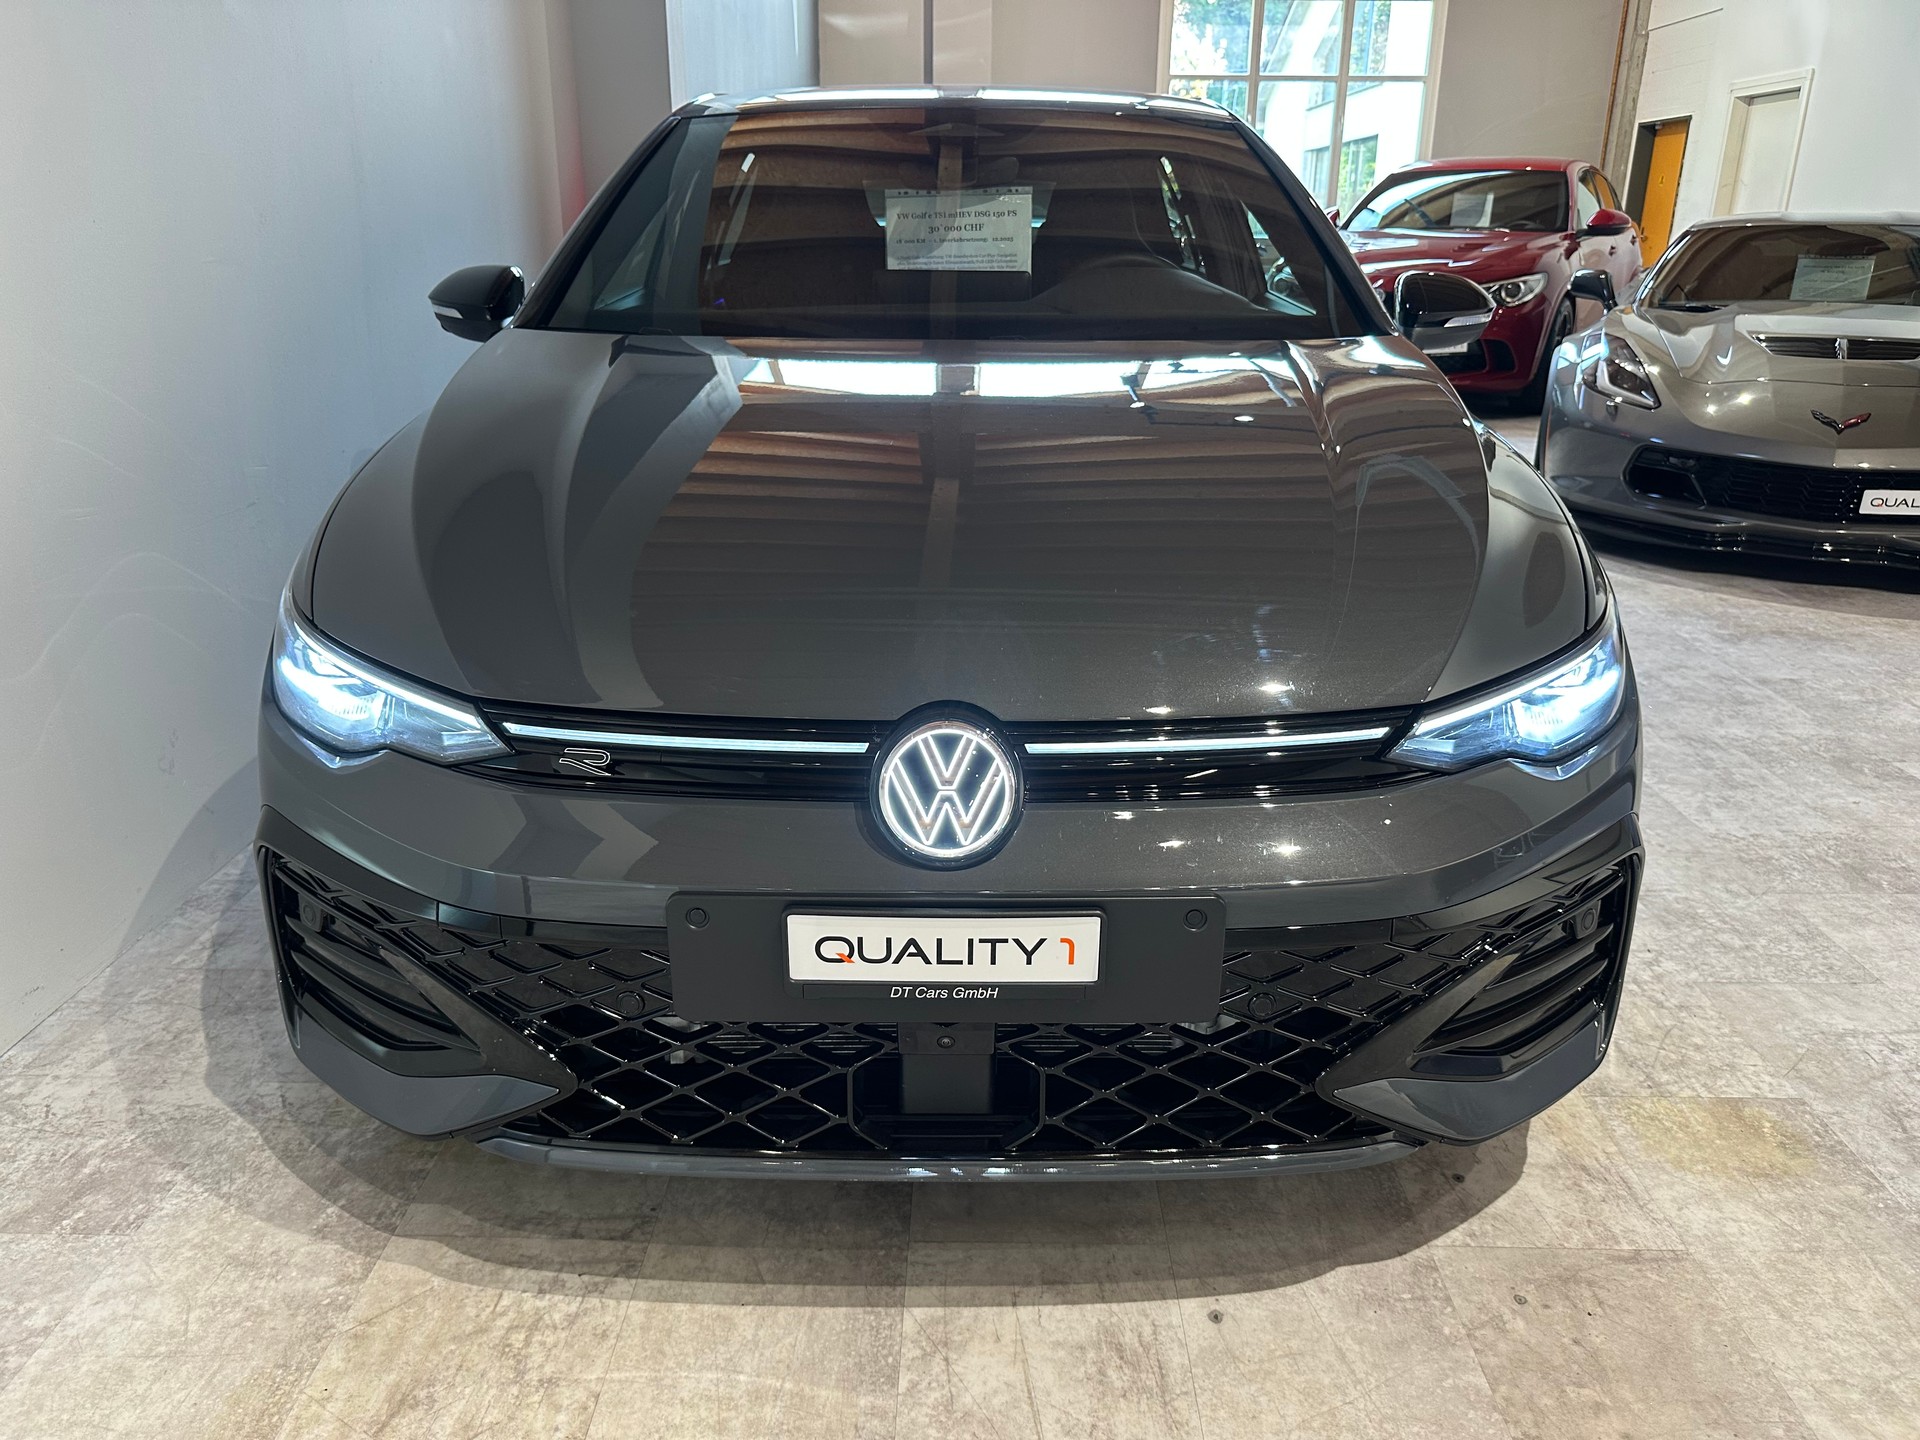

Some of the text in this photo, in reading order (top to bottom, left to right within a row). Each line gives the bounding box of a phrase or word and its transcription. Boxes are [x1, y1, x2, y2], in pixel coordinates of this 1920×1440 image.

[974, 210, 990, 218] DSG
[1007, 209, 1018, 217] PS
[963, 223, 985, 232] CHF
[883, 726, 1014, 856] VW
[814, 936, 1075, 965] QUALITY 1
[890, 986, 999, 999] DT Cars GmbH
